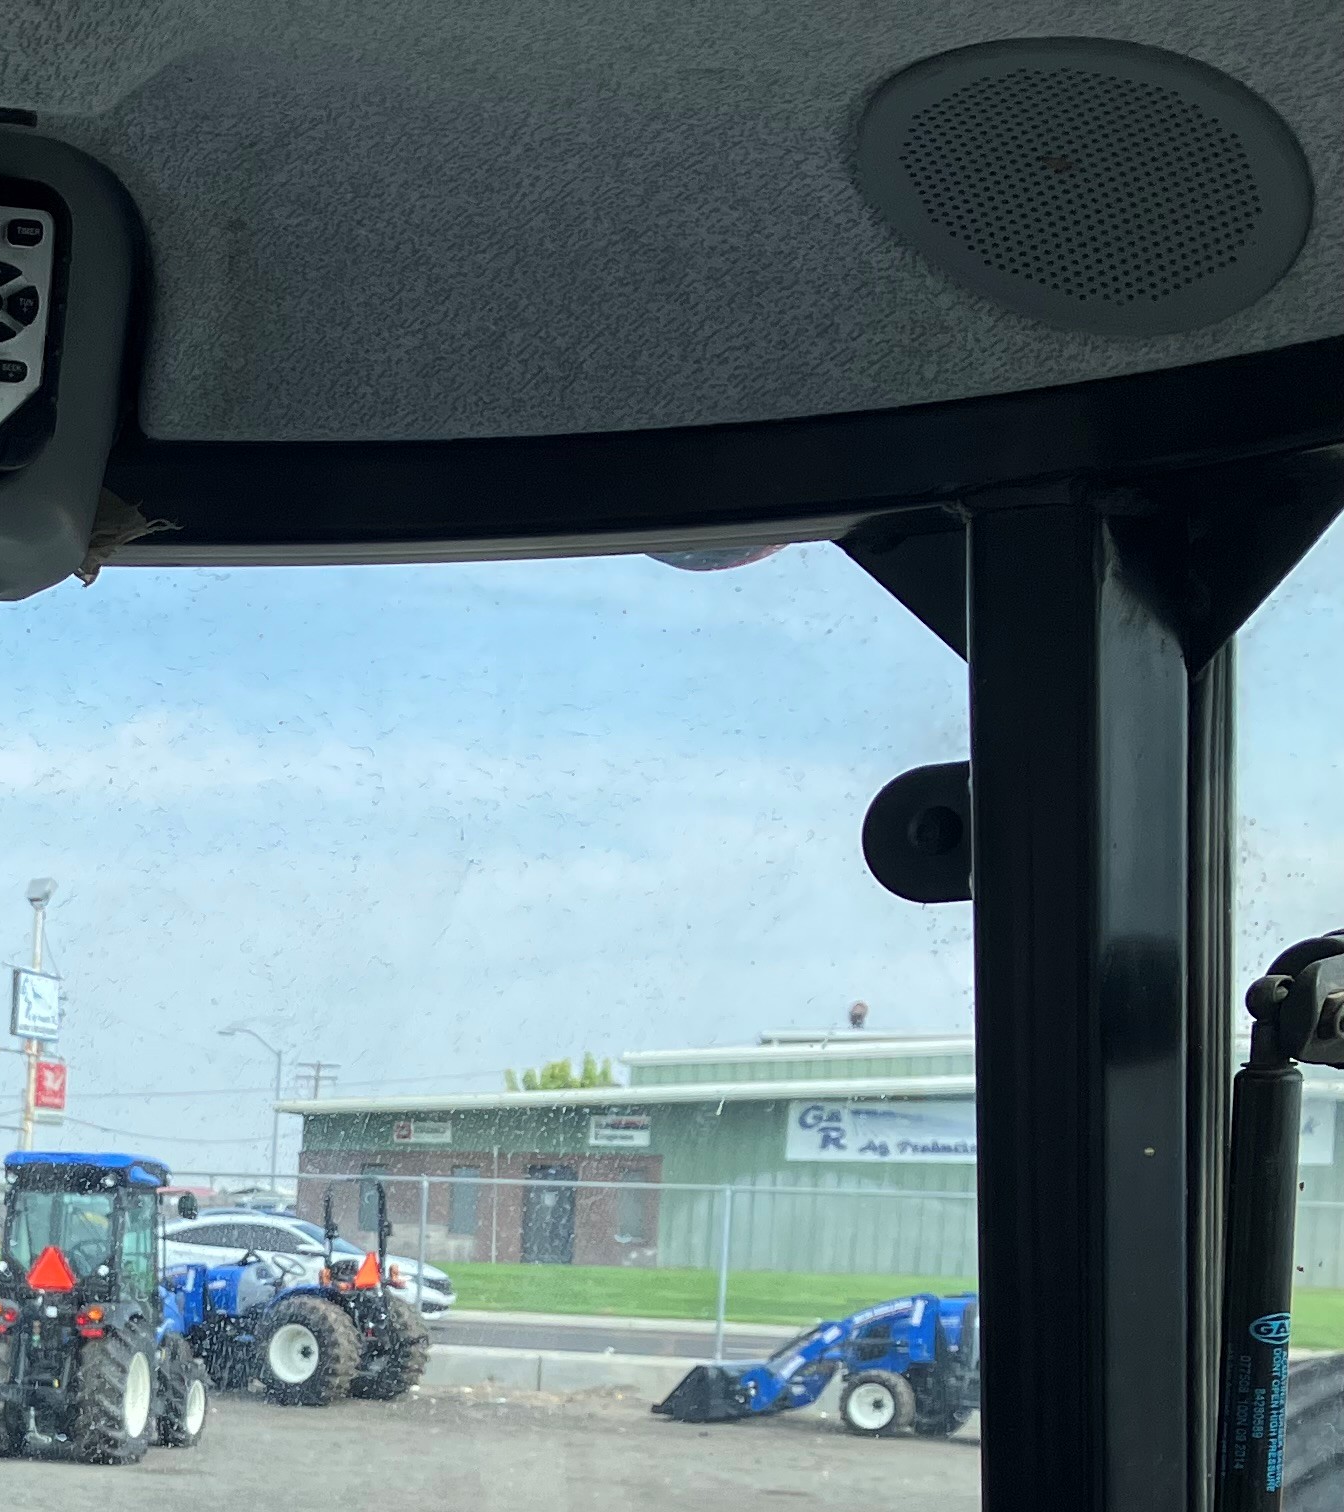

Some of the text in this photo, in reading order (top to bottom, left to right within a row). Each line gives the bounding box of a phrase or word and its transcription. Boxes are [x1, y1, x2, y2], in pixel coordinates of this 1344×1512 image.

[16, 226, 41, 237] TIMER
[1273, 1348, 1282, 1377] DONT
[1270, 1380, 1280, 1408] OPEN
[1269, 1410, 1278, 1437] HIGH
[1232, 1443, 1246, 1470] 2014
[1266, 1438, 1277, 1492] PRESSURE
